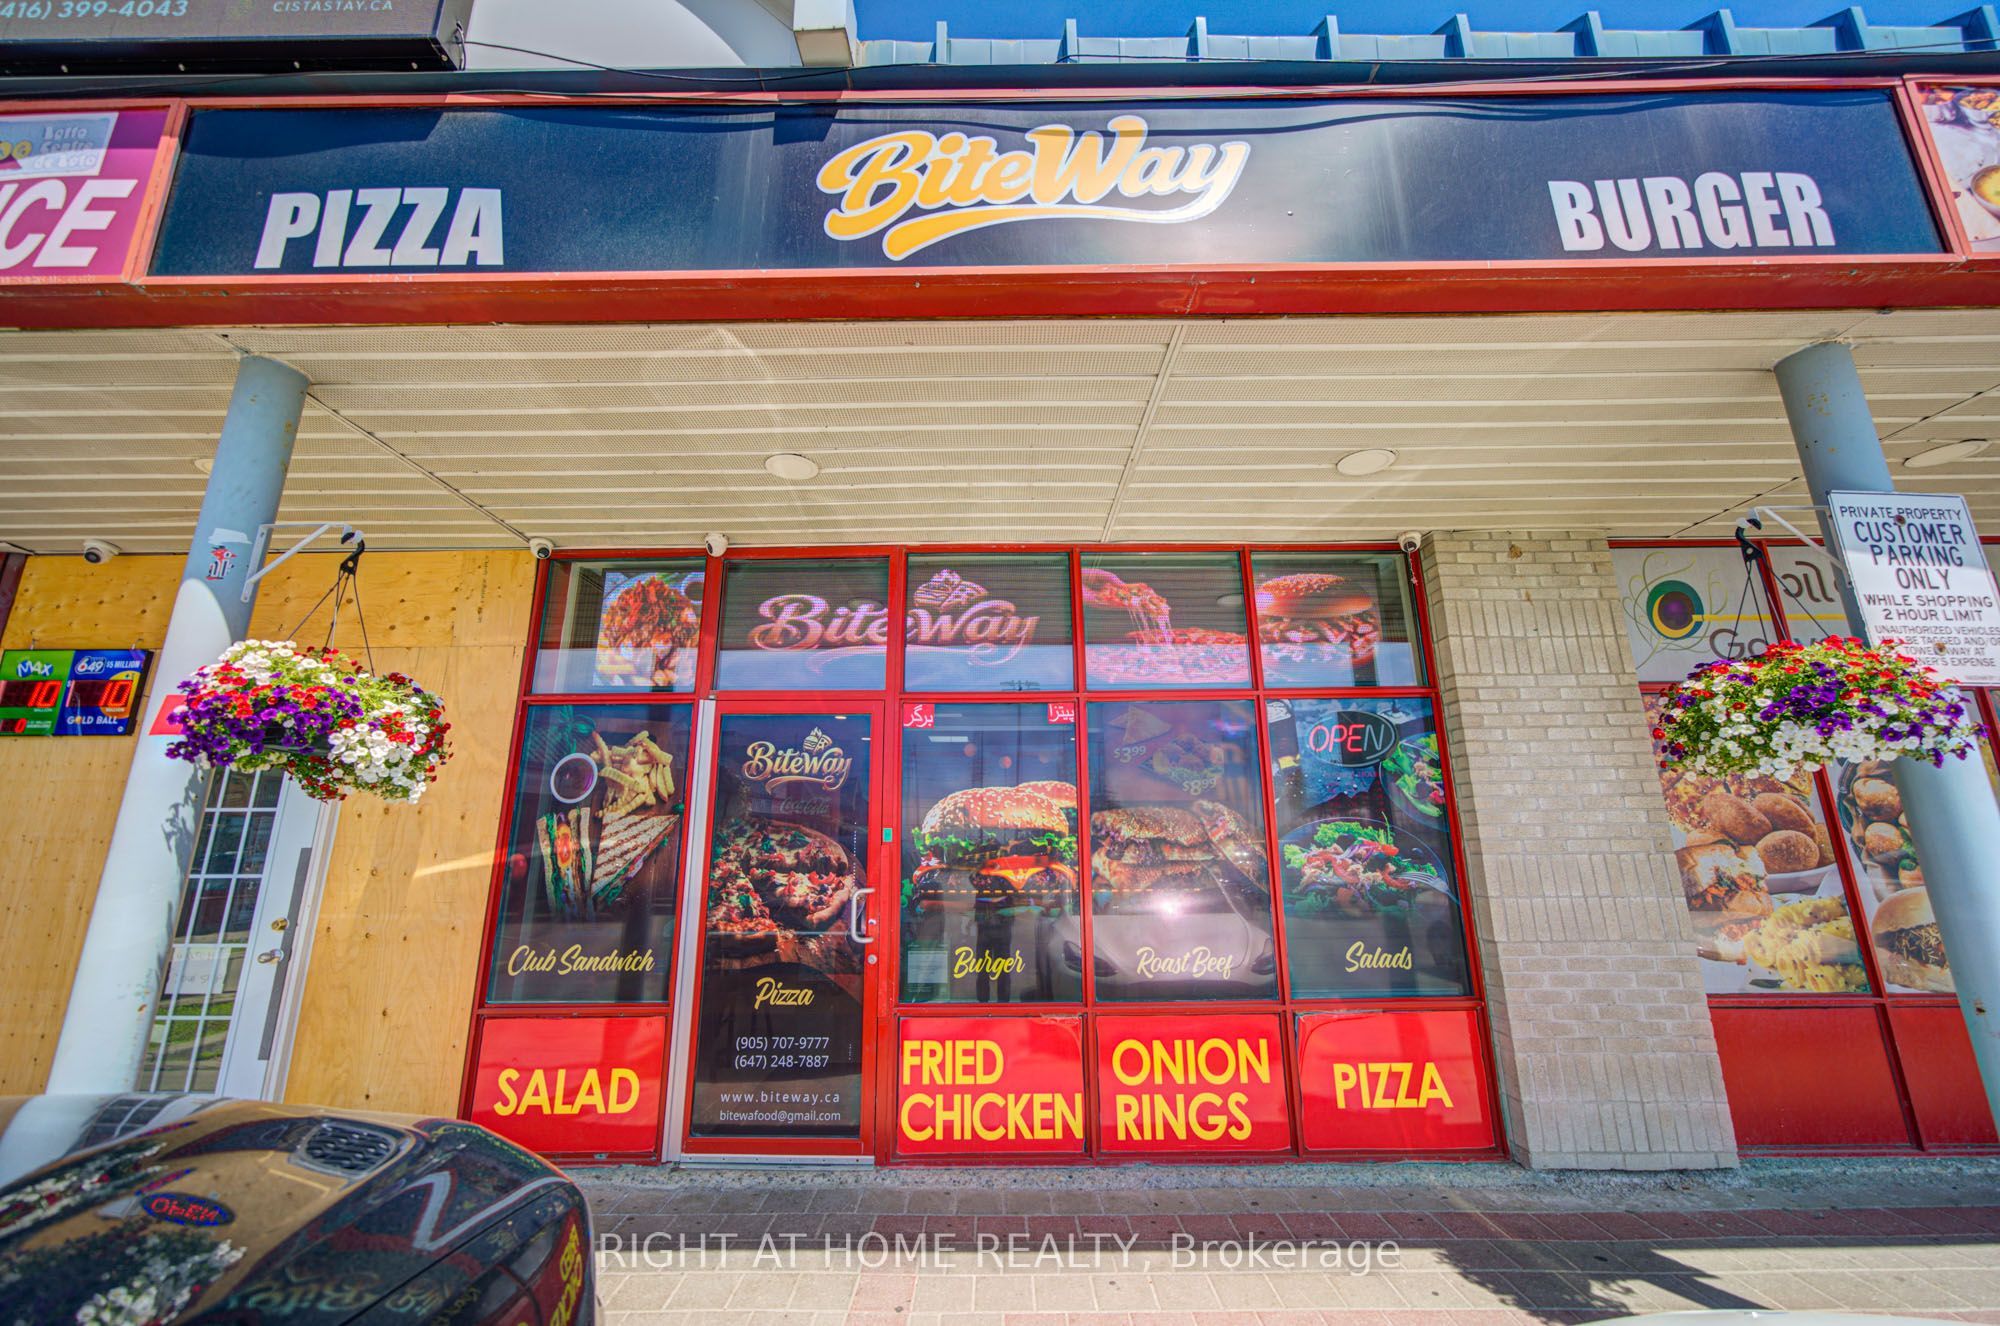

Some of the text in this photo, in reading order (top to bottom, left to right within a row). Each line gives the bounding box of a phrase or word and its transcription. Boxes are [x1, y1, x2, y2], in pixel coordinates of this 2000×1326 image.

[0, 0, 188, 20] 416) 399-4043
[272, 0, 394, 13] CISTASTAY.CA
[816, 114, 1251, 261] BiteWay
[0, 179, 139, 270] CE
[1547, 171, 1836, 252] BURGER
[254, 187, 504, 269] PIZZA
[1839, 505, 1962, 520] PRIVATE PROPERTY
[1853, 521, 1967, 545] CUSTOMER
[1869, 544, 1964, 567] PARKING
[1896, 568, 1951, 590] ONLY
[1863, 594, 1993, 607] WHILE SHOPPING
[1882, 608, 1983, 621] 2 HOUR LIMIT
[1874, 625, 1953, 635] UNAUTHORIZED
[77, 657, 104, 673] 649
[1903, 646, 1934, 656] TOWE
[1950, 657, 1997, 667] EXPENSE
[27, 679, 62, 708] 10
[98, 679, 134, 707] 10
[96, 715, 118, 725] BALL
[1308, 723, 1385, 753] OPEN
[742, 740, 853, 795] BiteWay
[507, 943, 656, 977] Club Sandwich
[953, 946, 1025, 981] Burger
[1136, 946, 1233, 980] Roast Beef
[1345, 940, 1413, 973] Salads
[754, 976, 815, 1010] Pizza
[735, 1036, 830, 1051] (905) 707-9777
[734, 1055, 830, 1069] (647) 248-7887
[902, 1039, 1005, 1086] FRIED
[1112, 1037, 1271, 1087] ONION
[493, 1067, 641, 1117] SALAD
[720, 1090, 841, 1106] www.biteway.ca
[1333, 1061, 1454, 1109] PIZZA
[719, 1110, 841, 1124] bitewafood@gmail.com
[901, 1092, 1084, 1142] CHICKEN
[1115, 1091, 1253, 1141] RINGS
